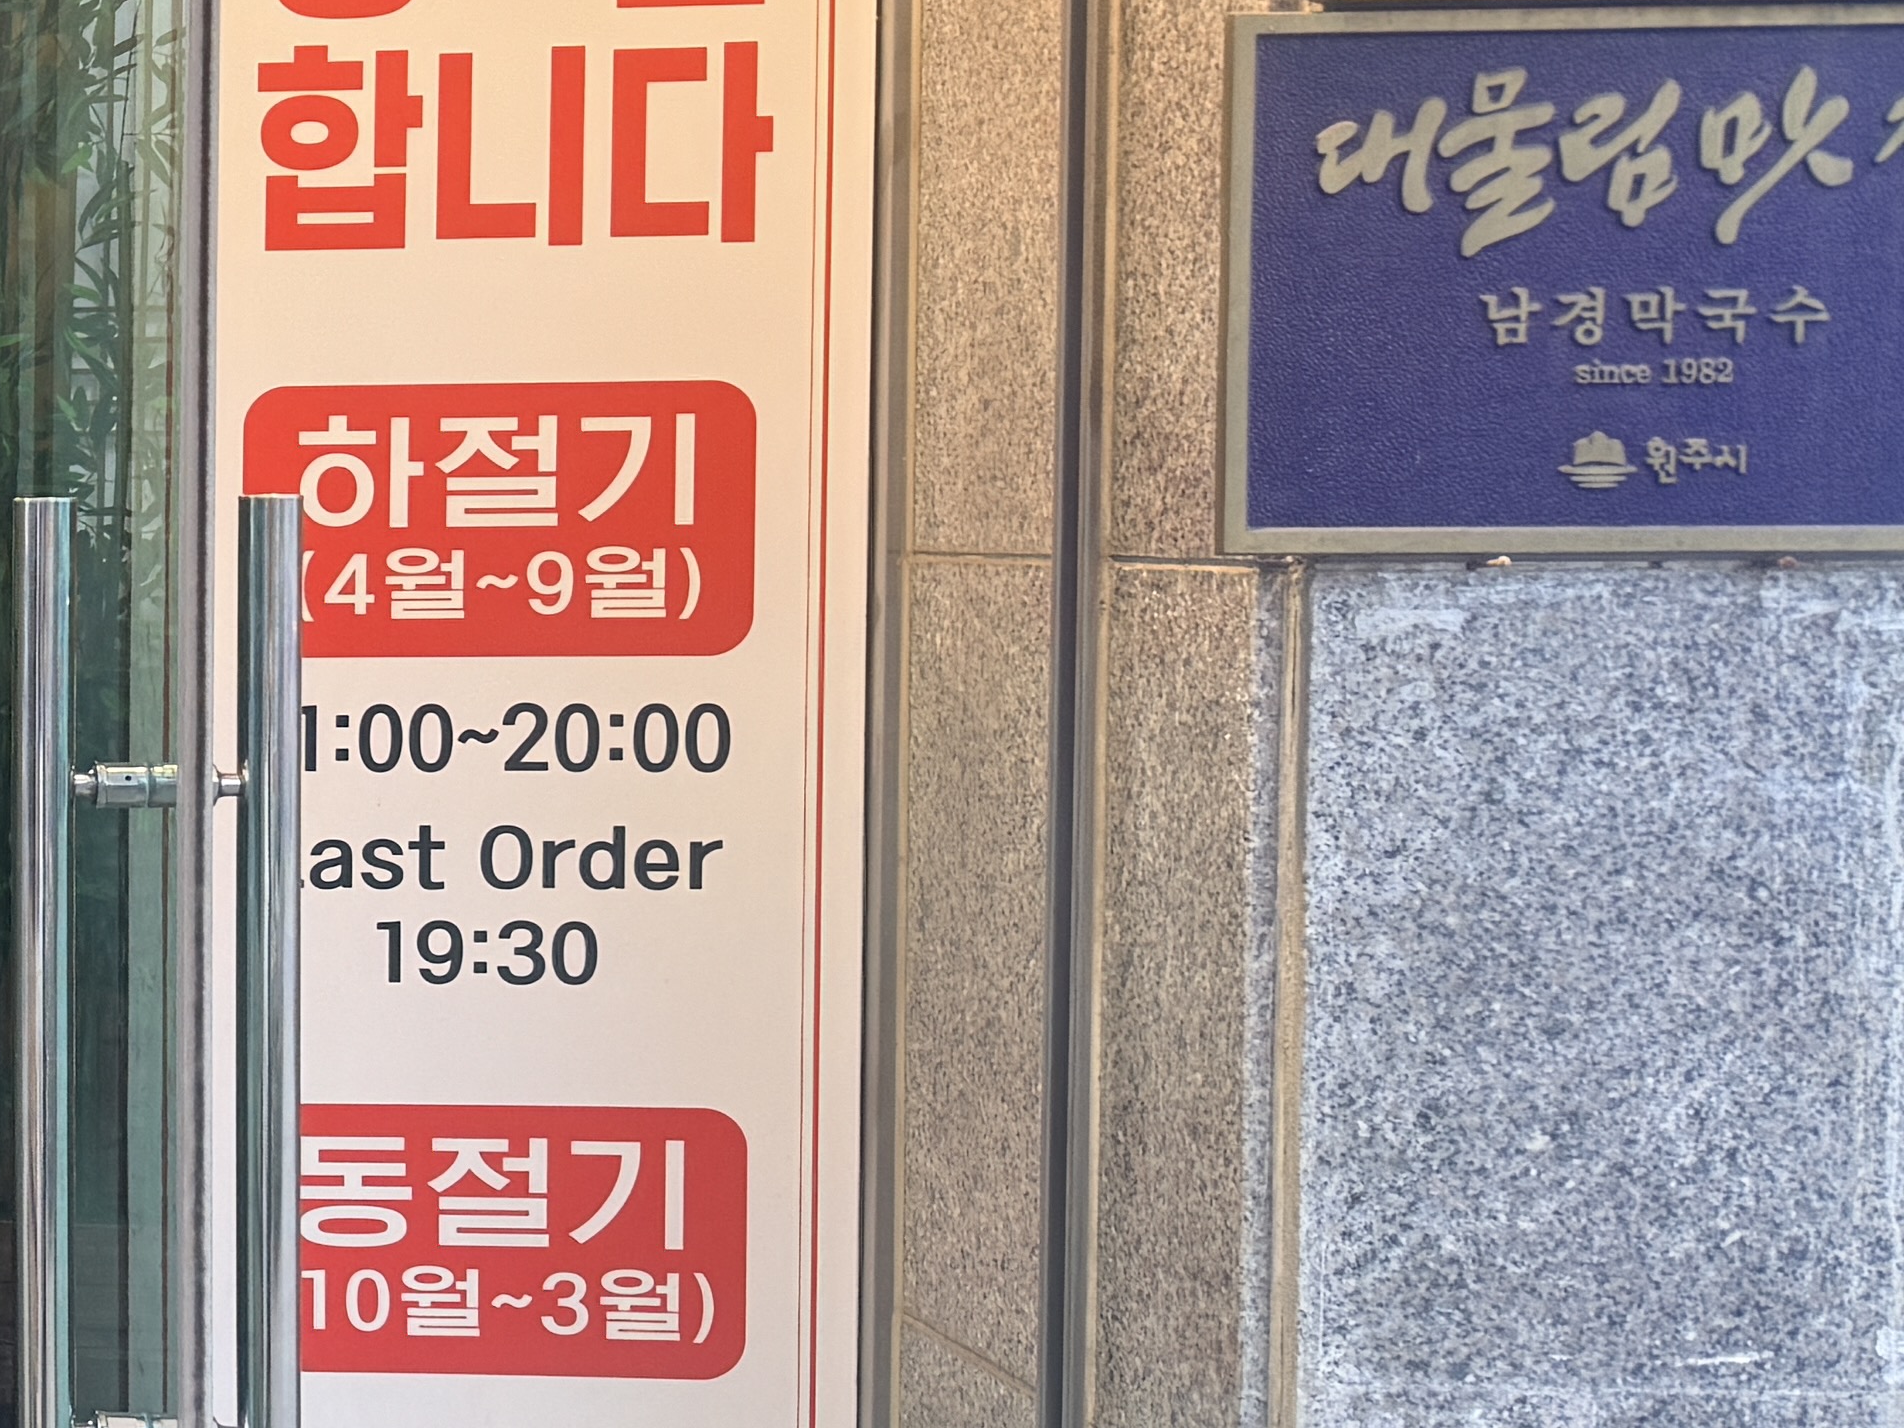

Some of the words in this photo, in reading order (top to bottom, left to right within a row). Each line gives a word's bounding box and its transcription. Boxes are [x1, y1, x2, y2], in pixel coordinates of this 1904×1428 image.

[257, 41, 774, 251] 합니다
[1479, 285, 1830, 347] 남경막국수
[1574, 360, 1651, 384] since
[1662, 357, 1734, 384] 1982
[298, 413, 696, 529] 하절기
[1644, 436, 1748, 483] 원주시
[301, 703, 732, 773] 1:00~20:00
[301, 824, 445, 889] ast
[480, 824, 724, 890] Order
[376, 919, 598, 986] 19:30
[299, 1135, 686, 1251] 동절기
[301, 1264, 715, 1344] 10월~3월)
